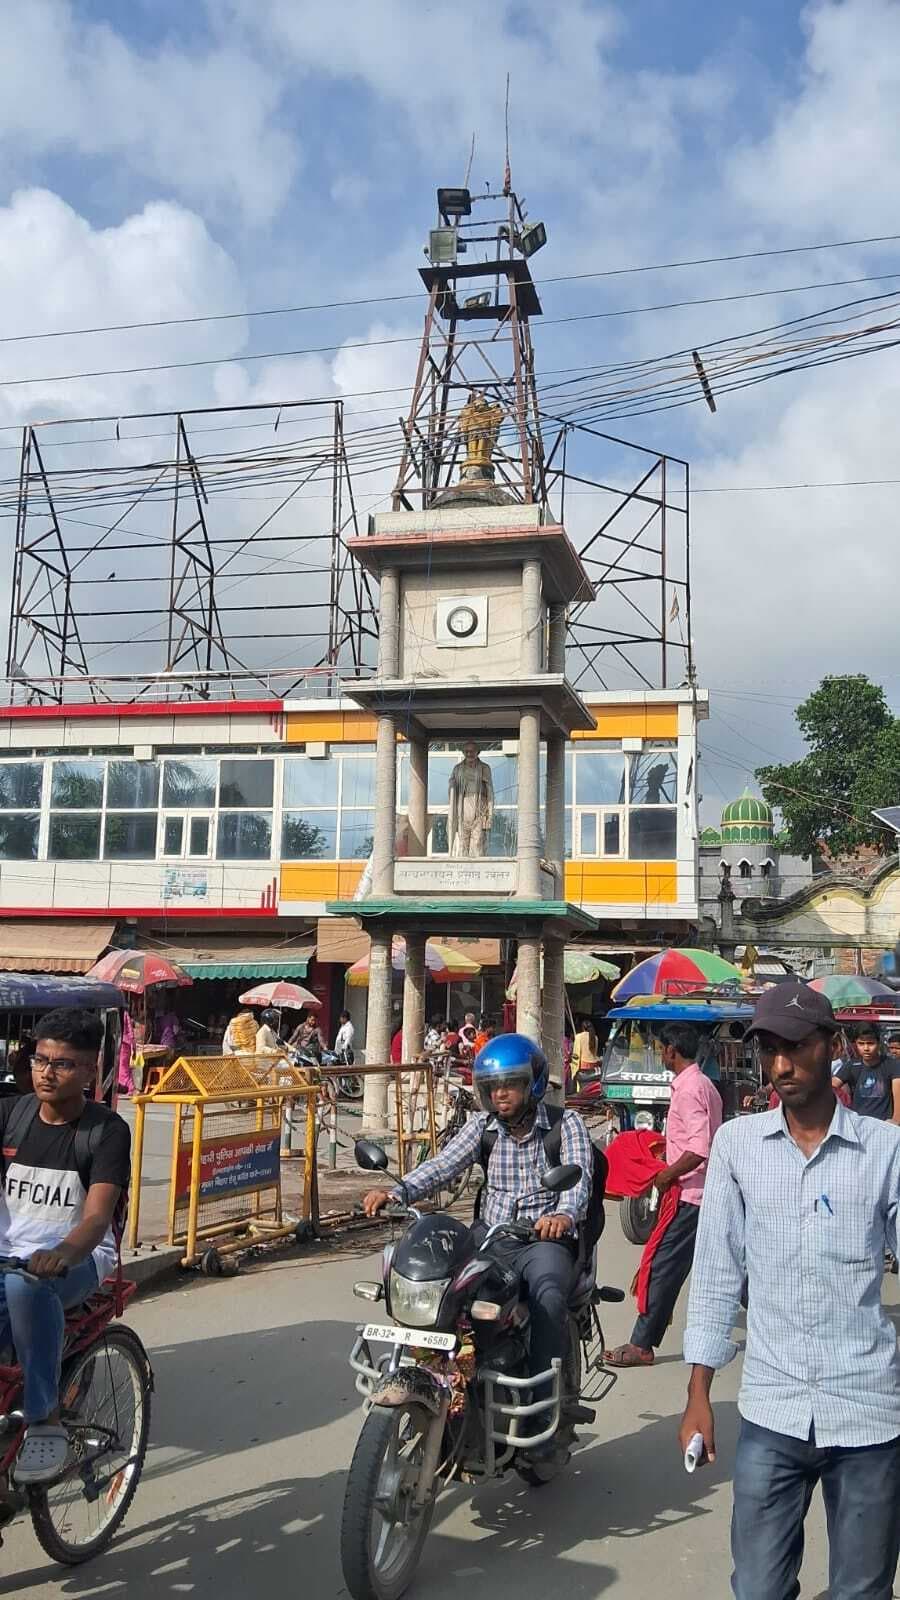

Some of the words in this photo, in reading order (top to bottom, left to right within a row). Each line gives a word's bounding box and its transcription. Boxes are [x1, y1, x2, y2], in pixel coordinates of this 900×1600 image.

[620, 1070, 674, 1082] सारथी
[216, 1147, 233, 1165] पुलिस
[427, 1335, 449, 1346] 6580
